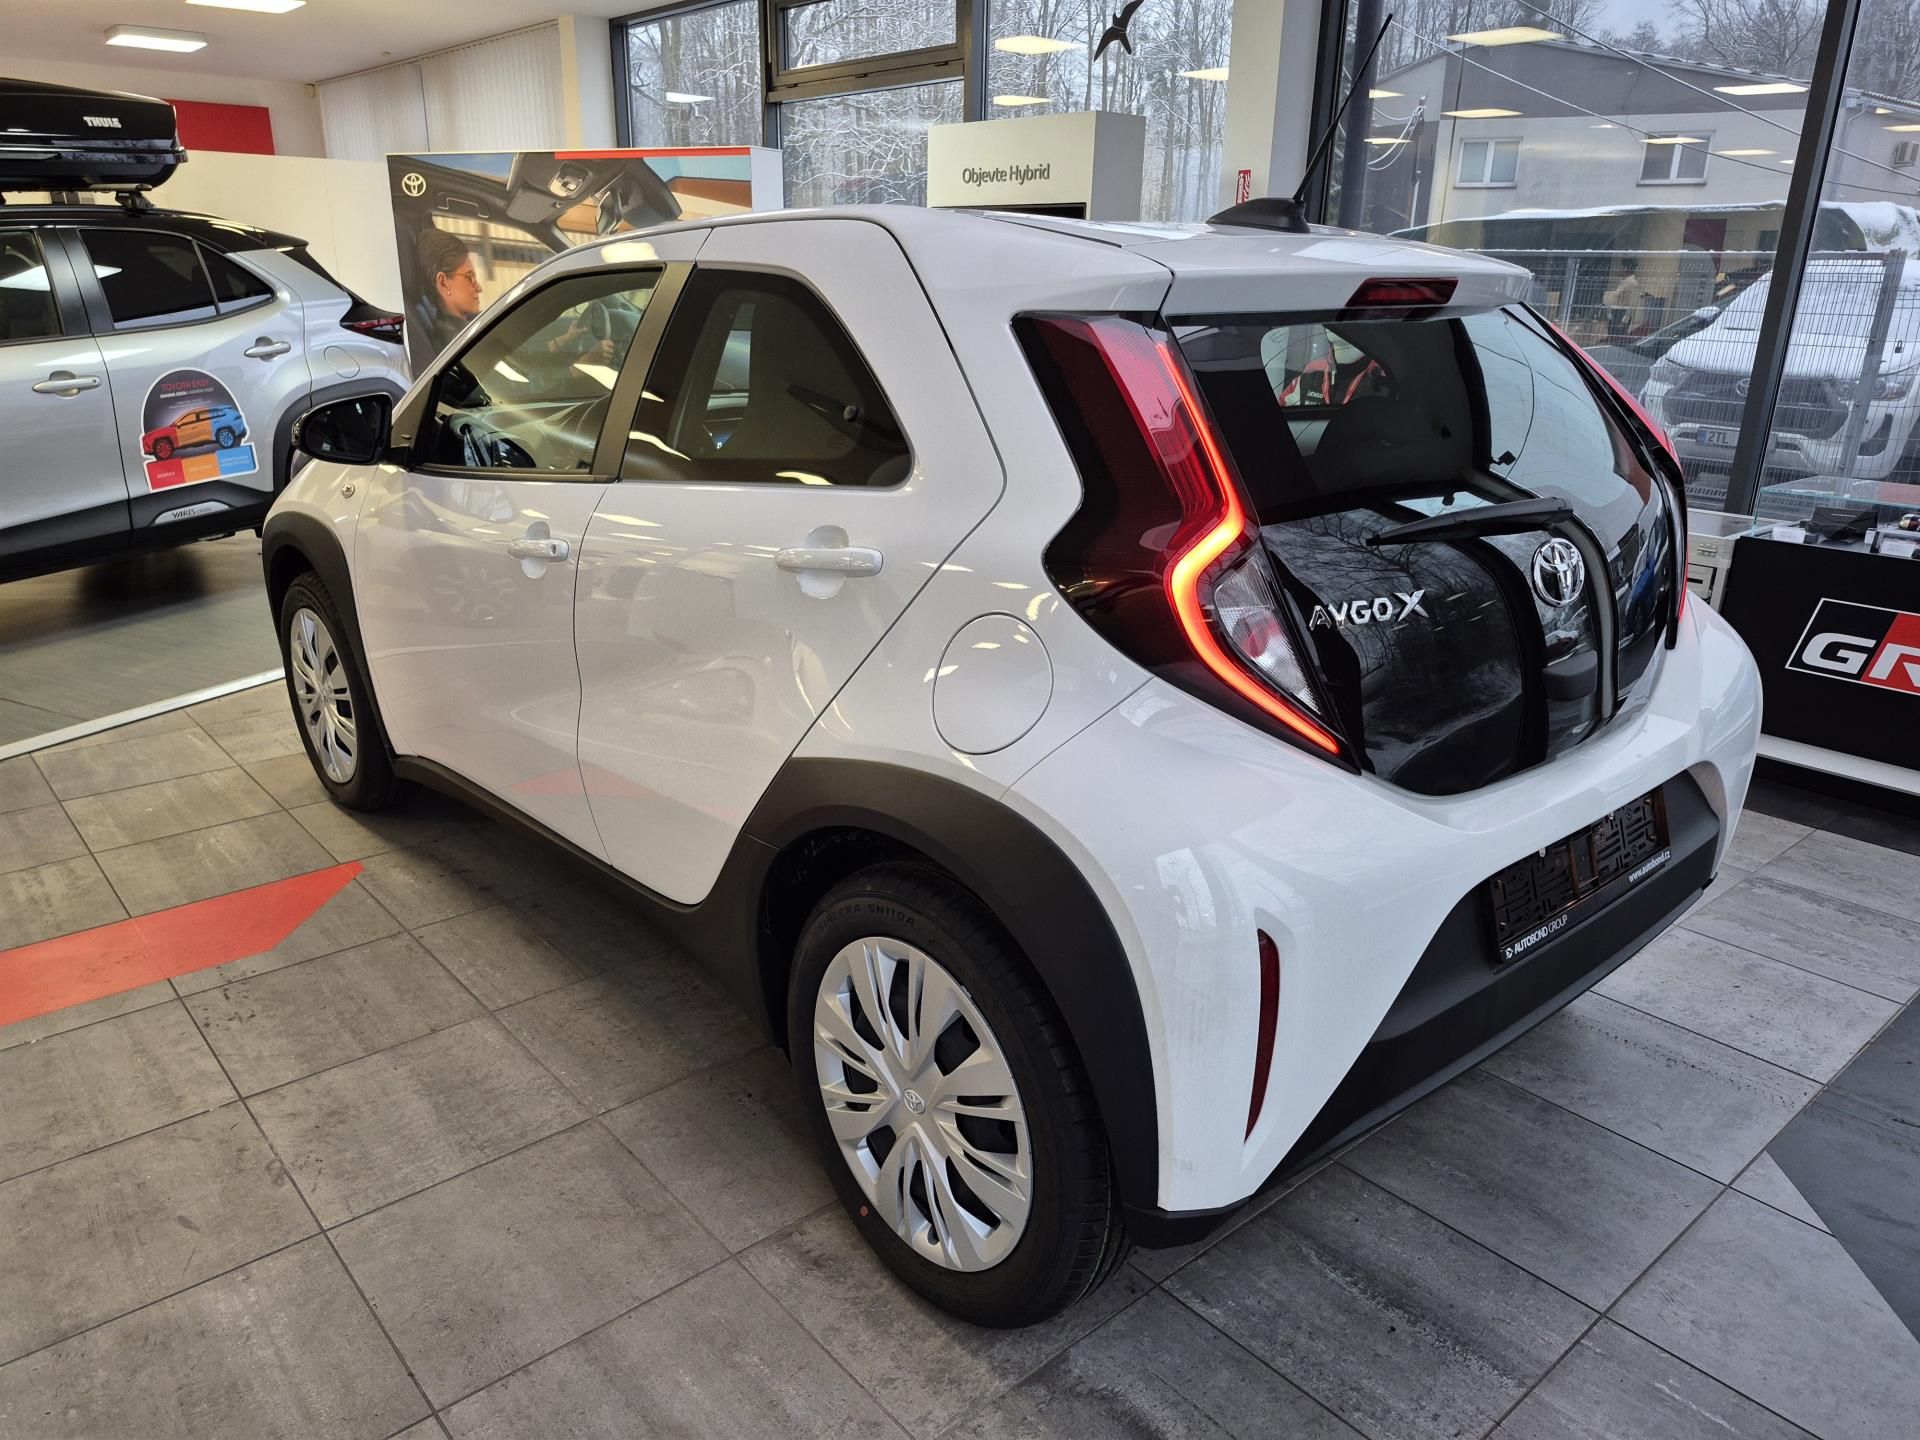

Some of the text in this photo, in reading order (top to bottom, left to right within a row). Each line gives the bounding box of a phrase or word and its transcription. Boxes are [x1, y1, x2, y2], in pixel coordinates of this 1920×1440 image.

[82, 115, 122, 129] THULE
[962, 162, 1051, 188] Objevte Hybrid
[1708, 430, 1729, 445] 2TL
[172, 508, 196, 519] YARIS
[1514, 914, 1568, 955] AUTOBOND GROUP
